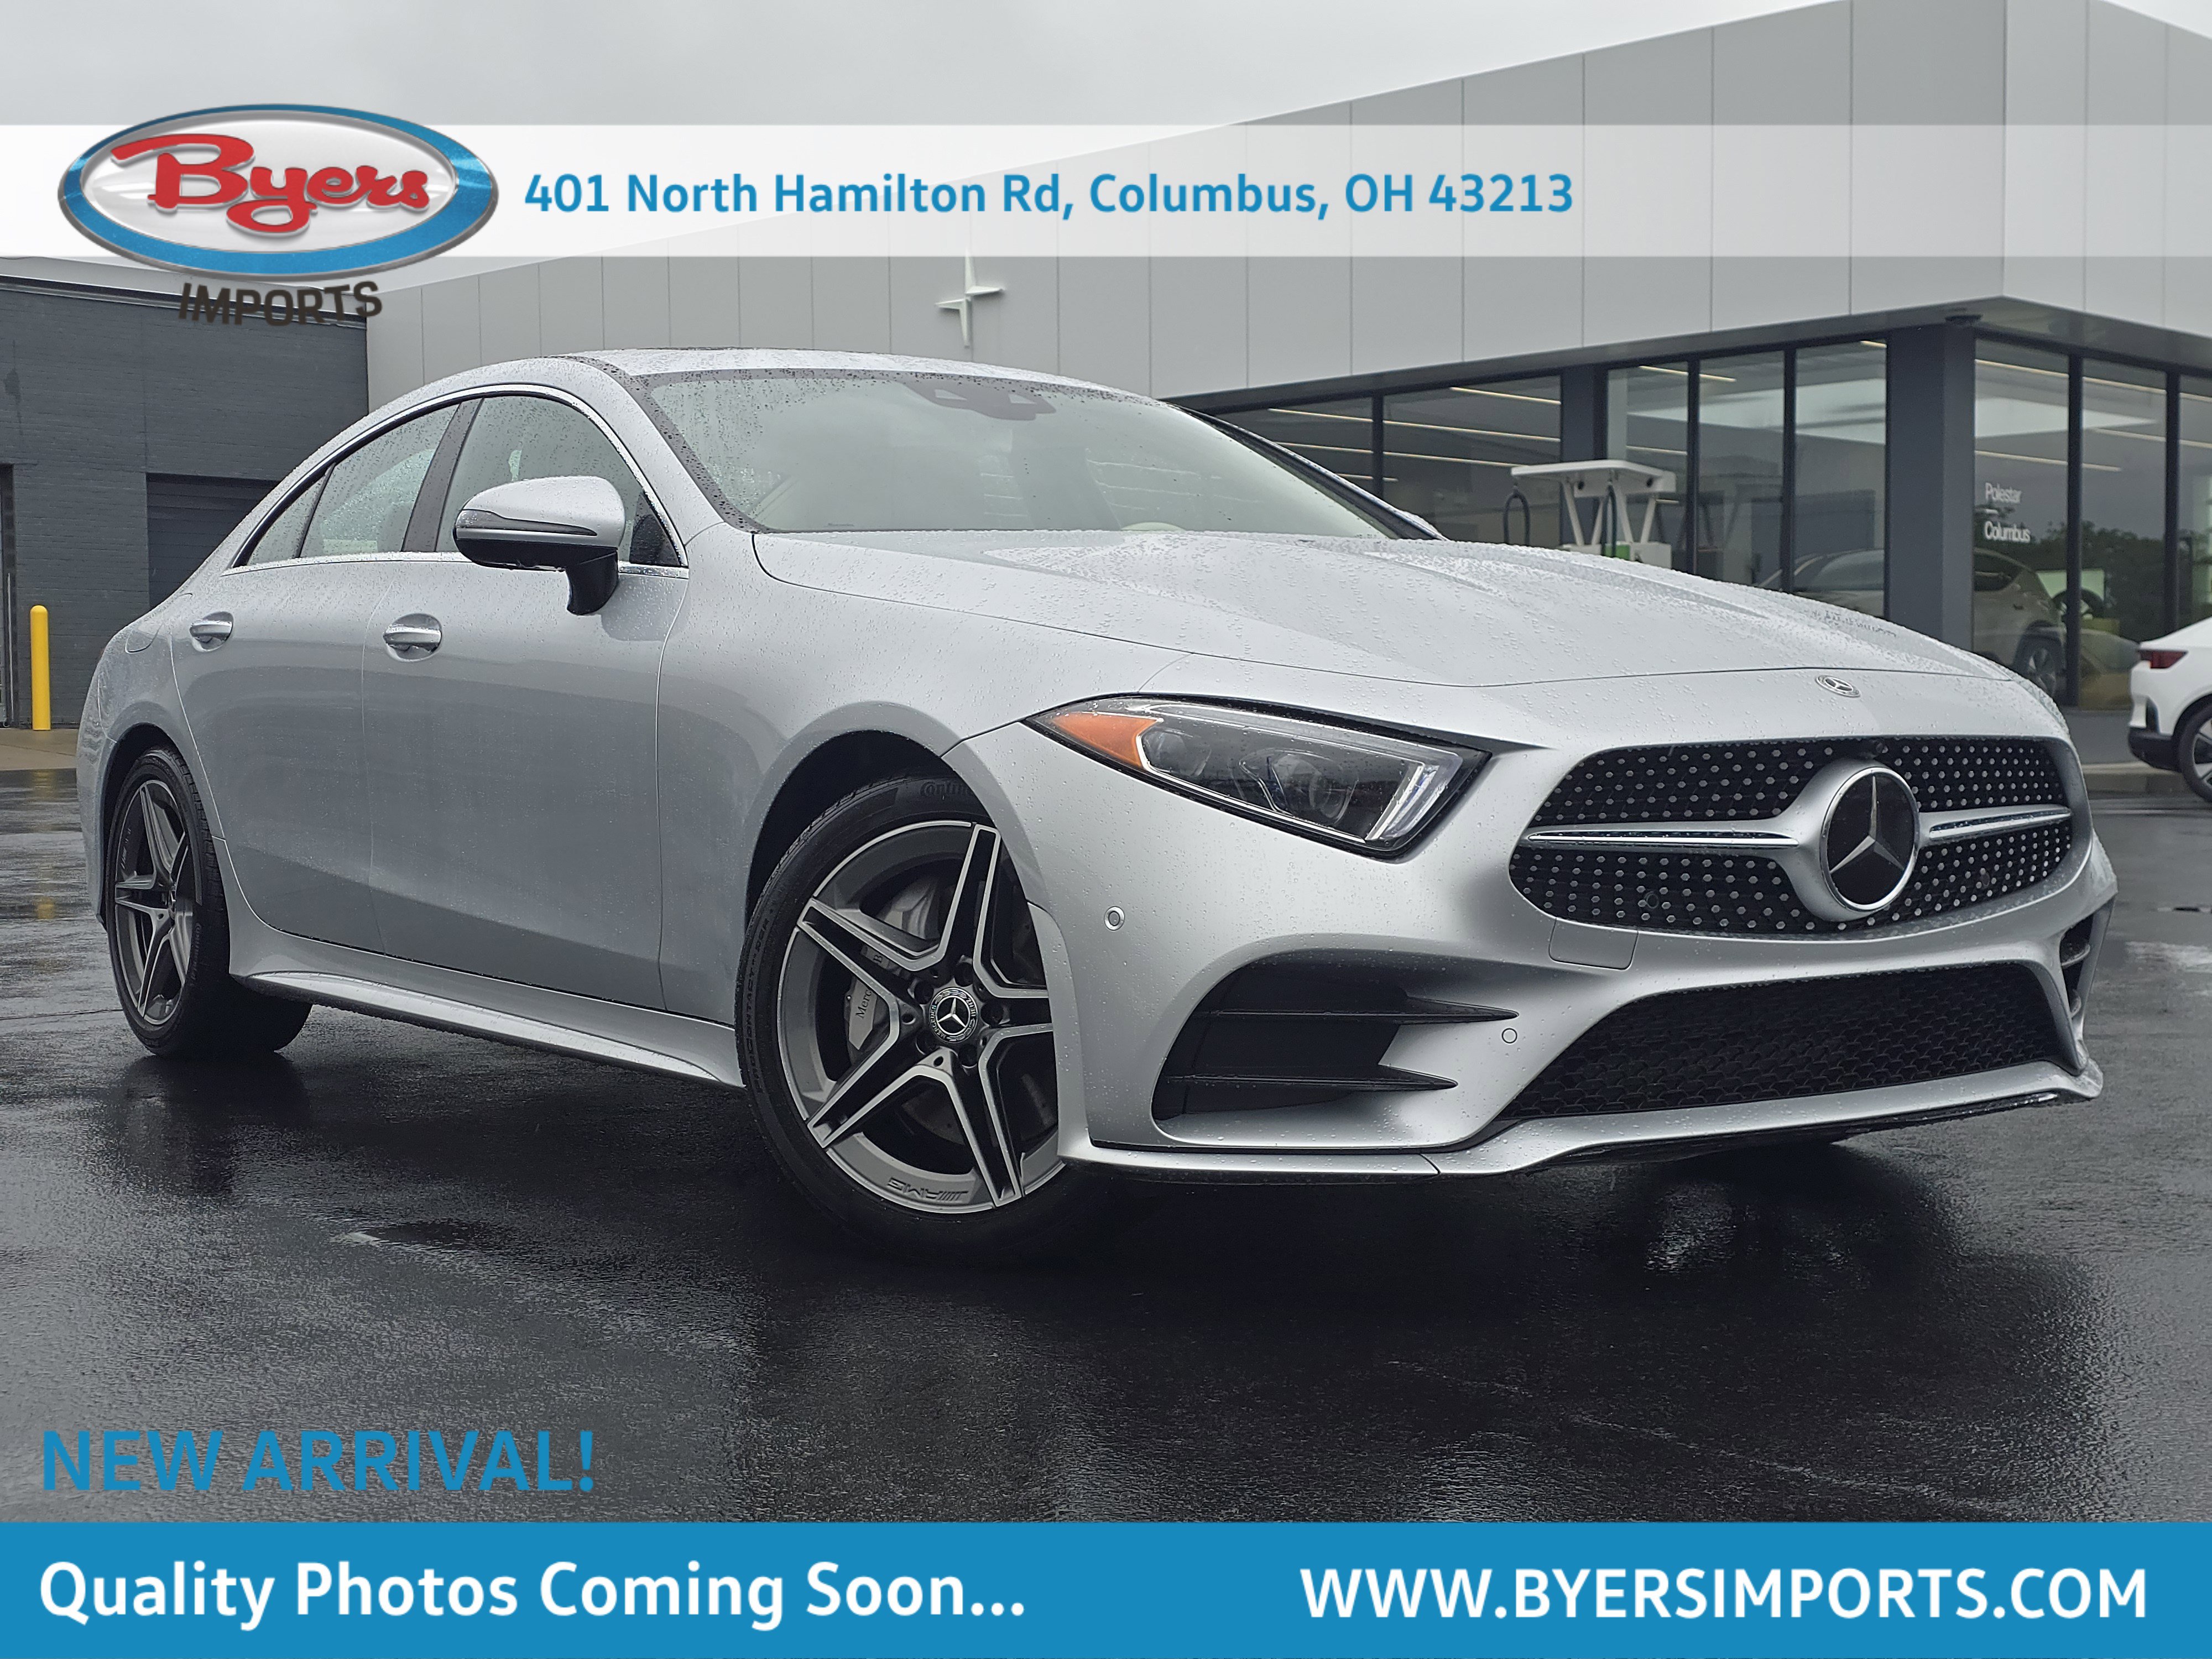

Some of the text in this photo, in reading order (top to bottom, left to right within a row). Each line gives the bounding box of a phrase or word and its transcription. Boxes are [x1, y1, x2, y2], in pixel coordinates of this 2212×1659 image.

[1985, 482, 2022, 504] Polestar
[1984, 520, 2031, 543] Columbus
[855, 989, 872, 1019] Merc
[887, 1177, 941, 1199] AMG
